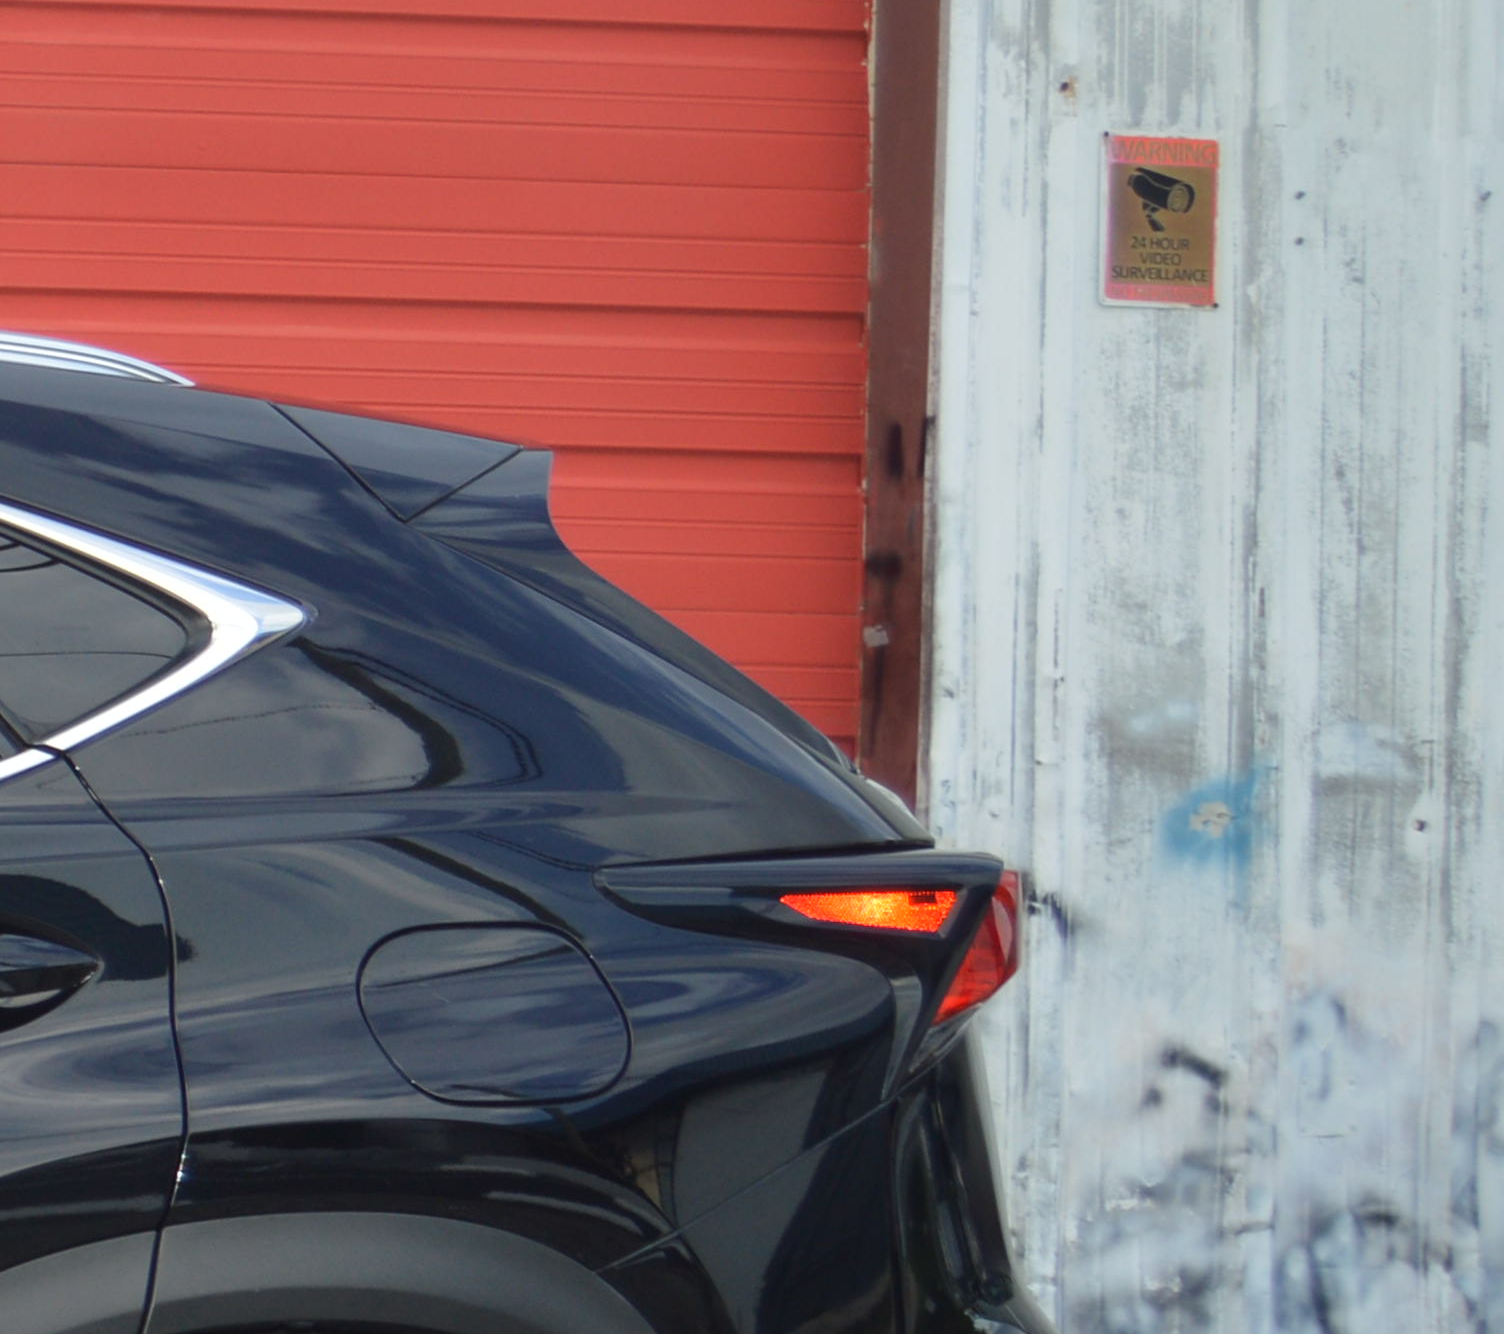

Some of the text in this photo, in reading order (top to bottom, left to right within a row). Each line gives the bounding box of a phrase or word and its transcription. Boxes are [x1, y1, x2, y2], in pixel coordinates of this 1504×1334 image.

[1112, 141, 1217, 165] WARNING
[1130, 236, 1191, 251] 24 HOUR
[1140, 252, 1182, 265] VIDEO
[1111, 265, 1208, 283] SURVEILLANCE
